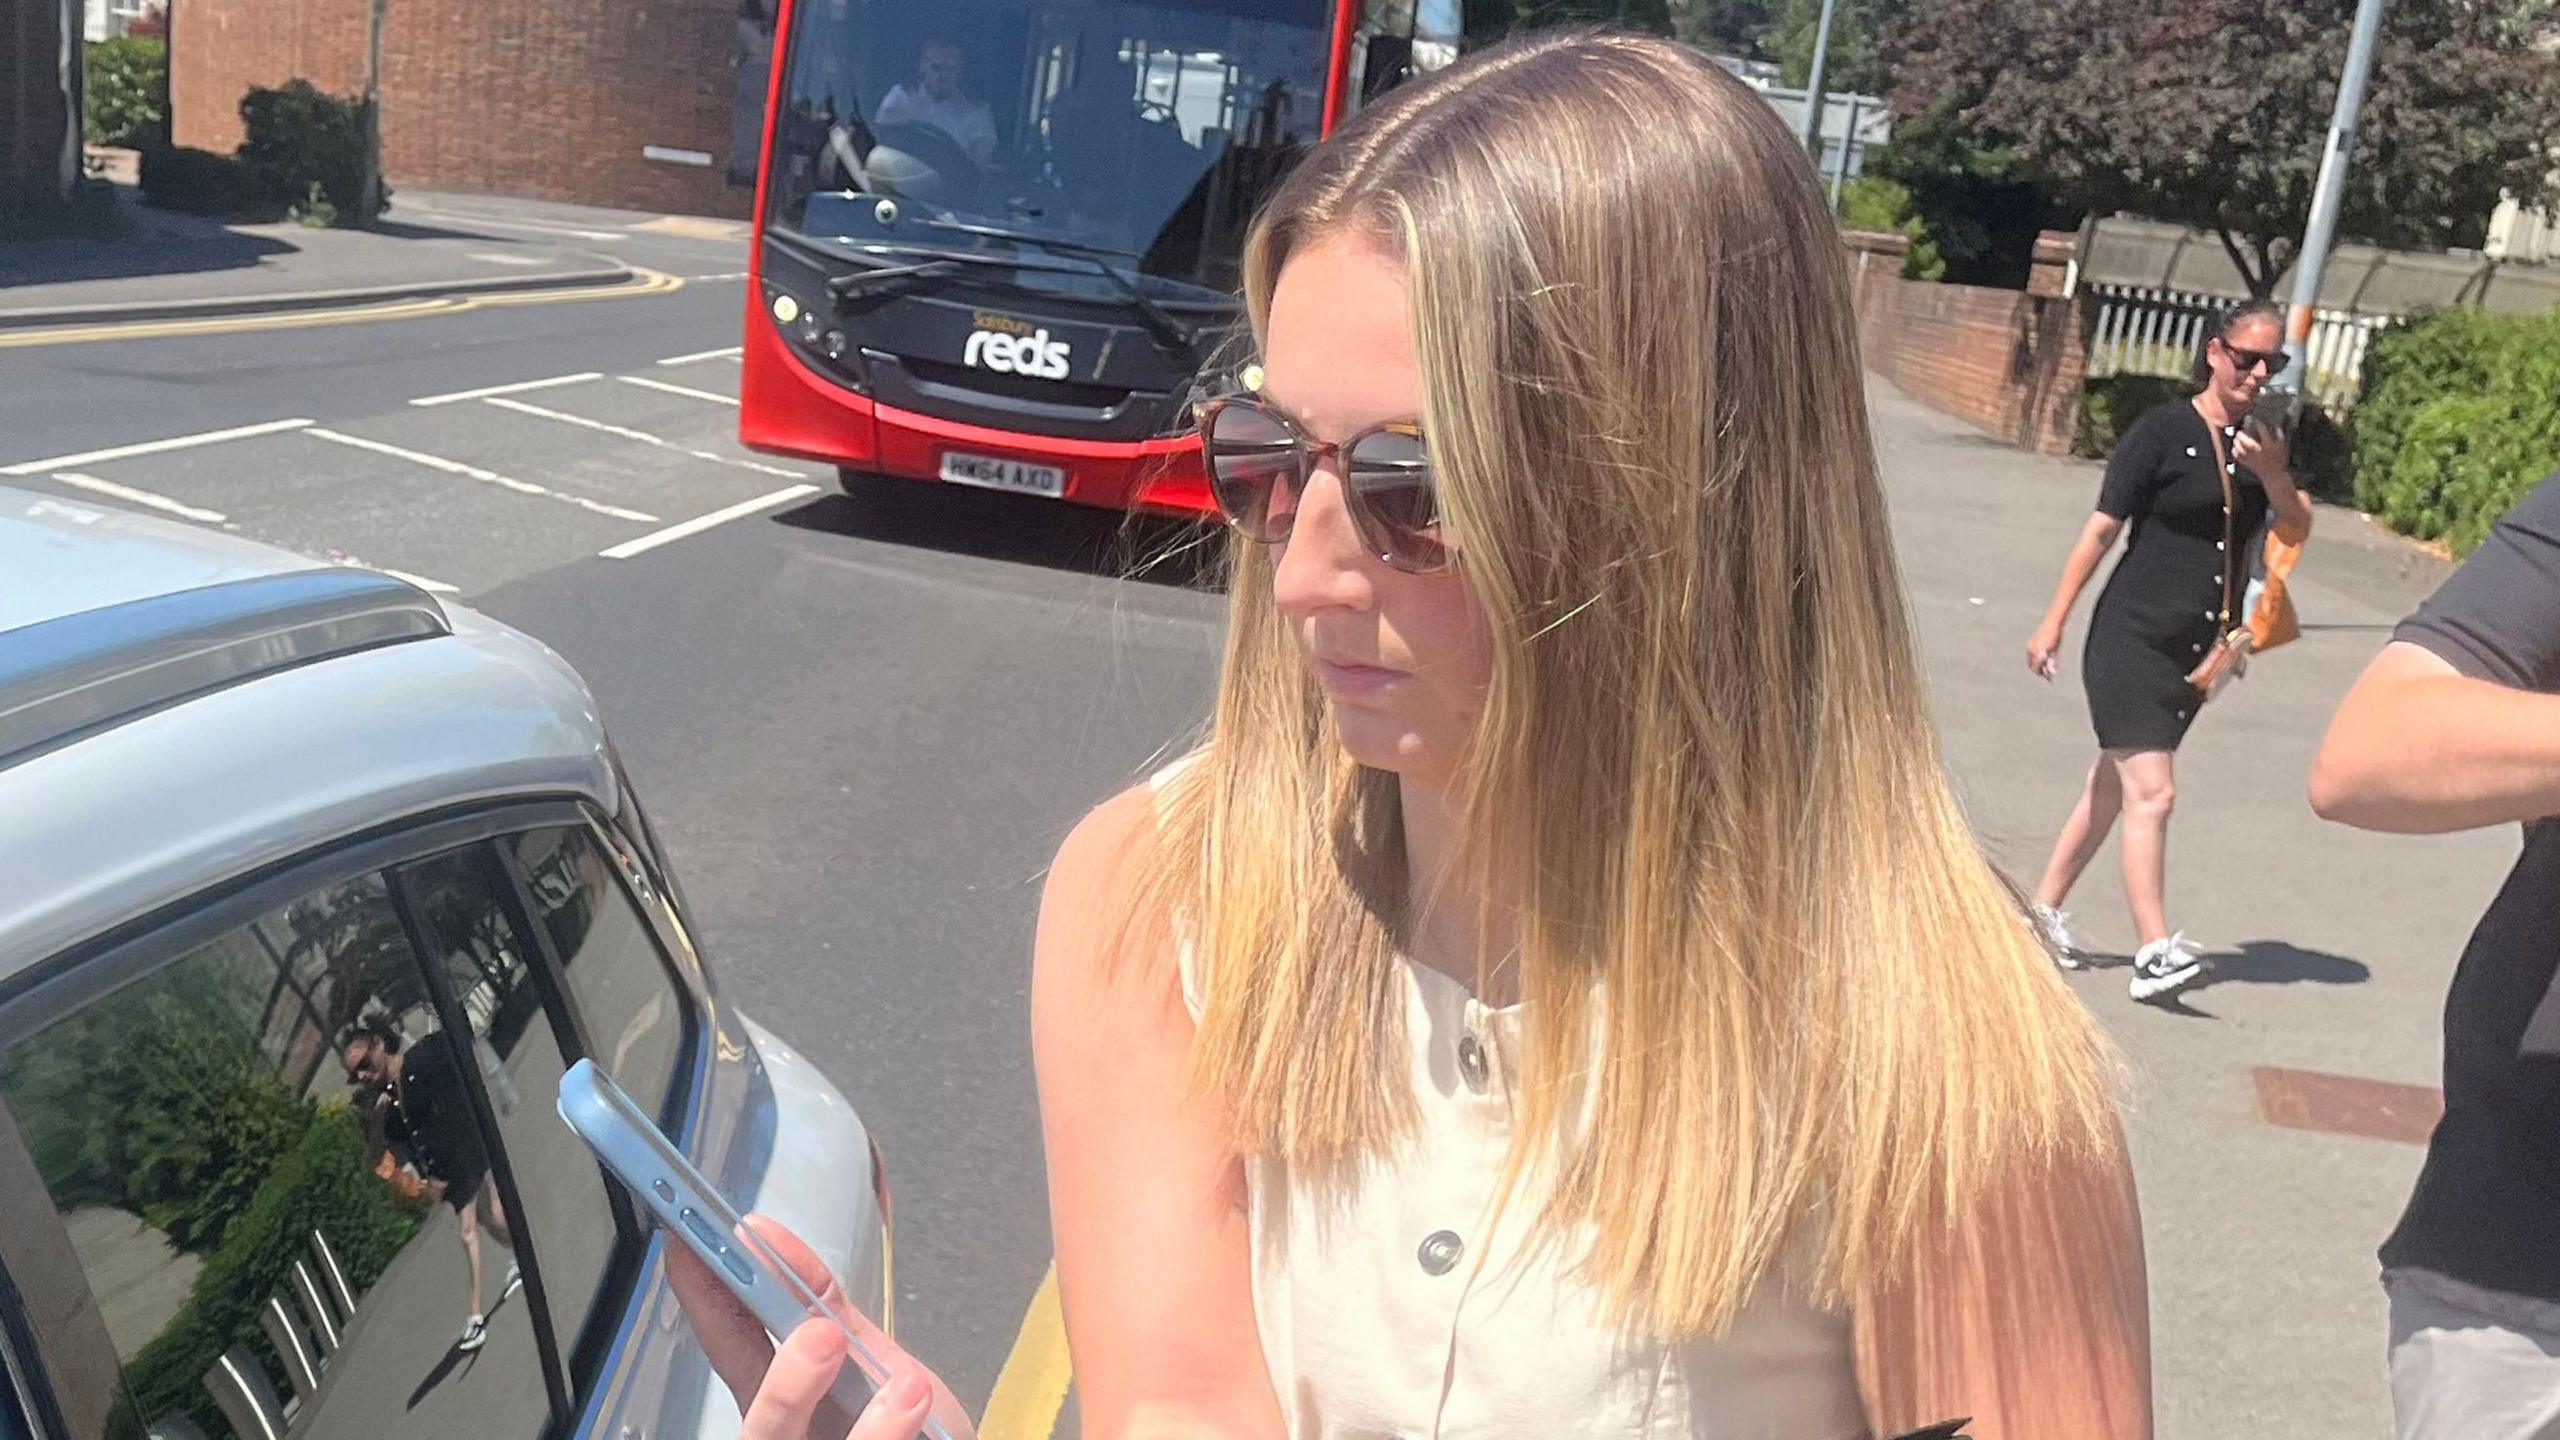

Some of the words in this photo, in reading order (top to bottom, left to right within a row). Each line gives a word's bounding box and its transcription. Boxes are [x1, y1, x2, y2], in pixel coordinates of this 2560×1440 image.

[963, 328, 1071, 380] reds
[949, 455, 1005, 481] HW64
[1012, 465, 1054, 490] AXD
